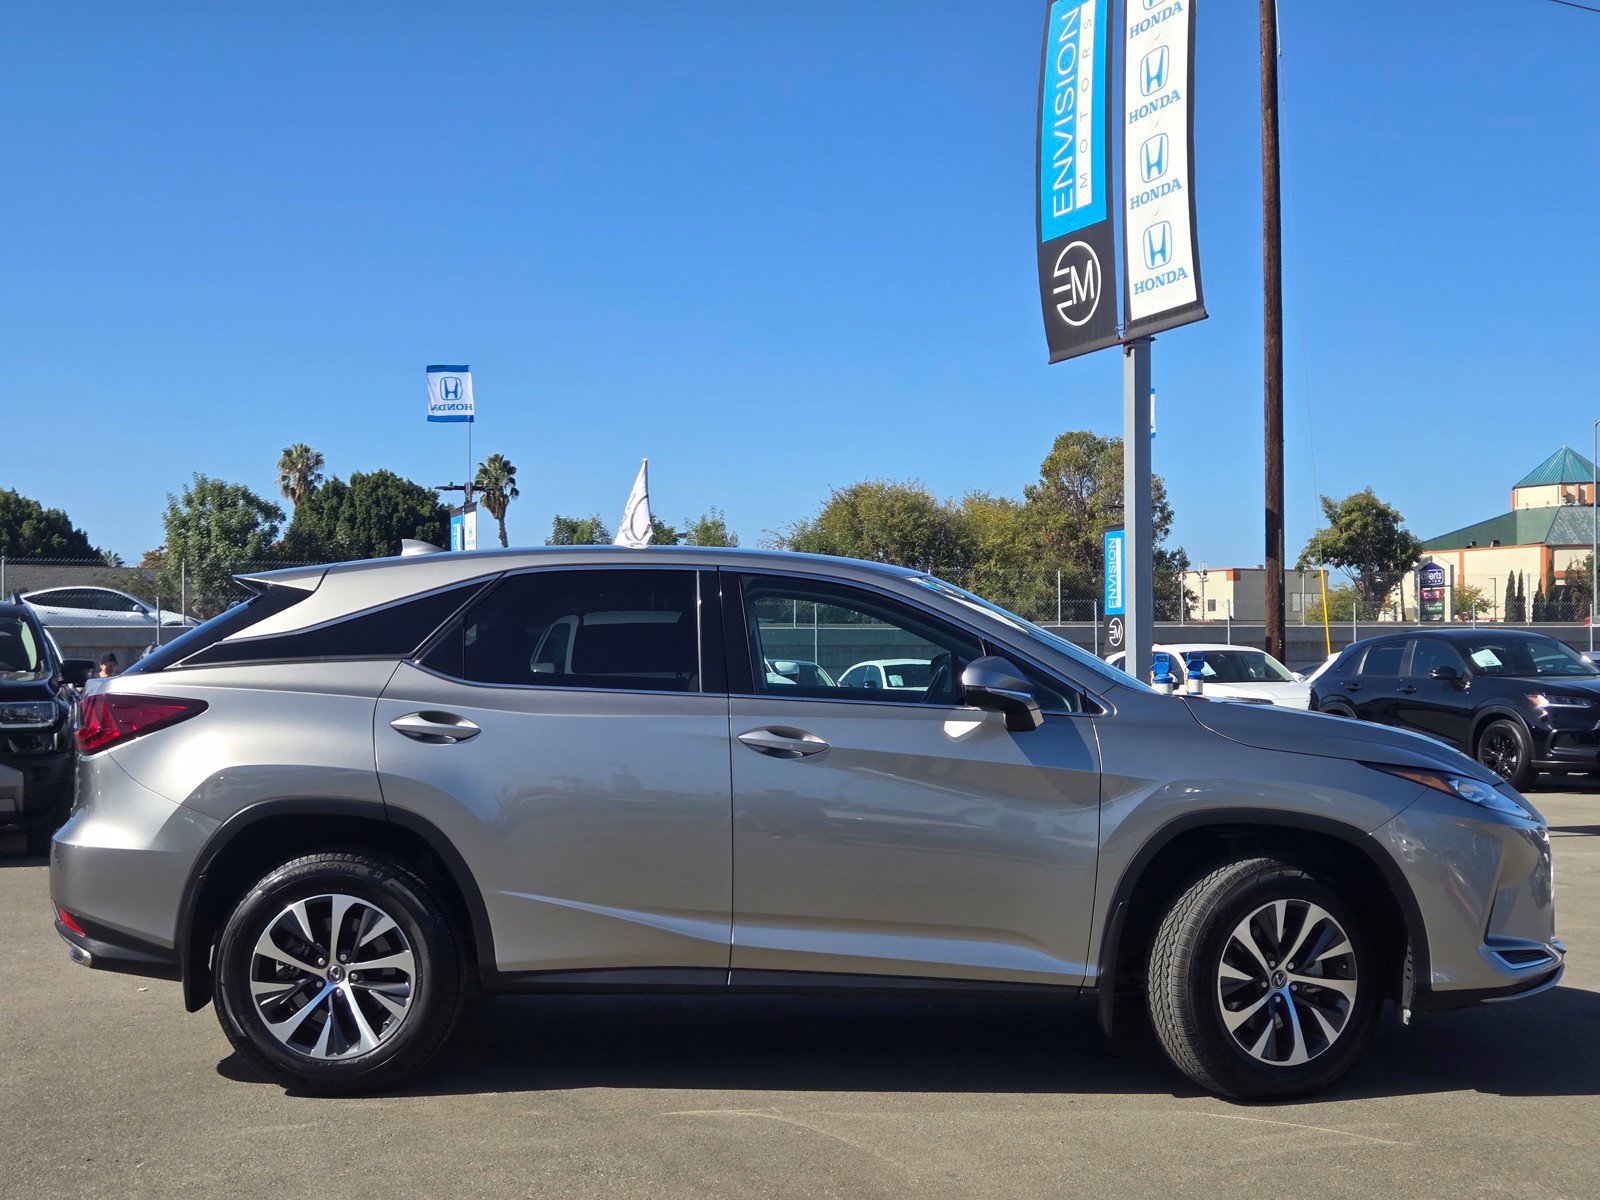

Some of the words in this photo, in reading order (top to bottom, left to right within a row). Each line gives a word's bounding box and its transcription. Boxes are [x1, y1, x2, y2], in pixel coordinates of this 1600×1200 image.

[1129, 1, 1183, 39] HONDA
[1053, 7, 1080, 218] ENVISION
[1079, 18, 1092, 189] MOTORS
[1129, 89, 1182, 124] HONDA
[1129, 178, 1183, 211] HONDA
[1133, 267, 1189, 295] HONDA
[1108, 537, 1117, 609] ENVISION
